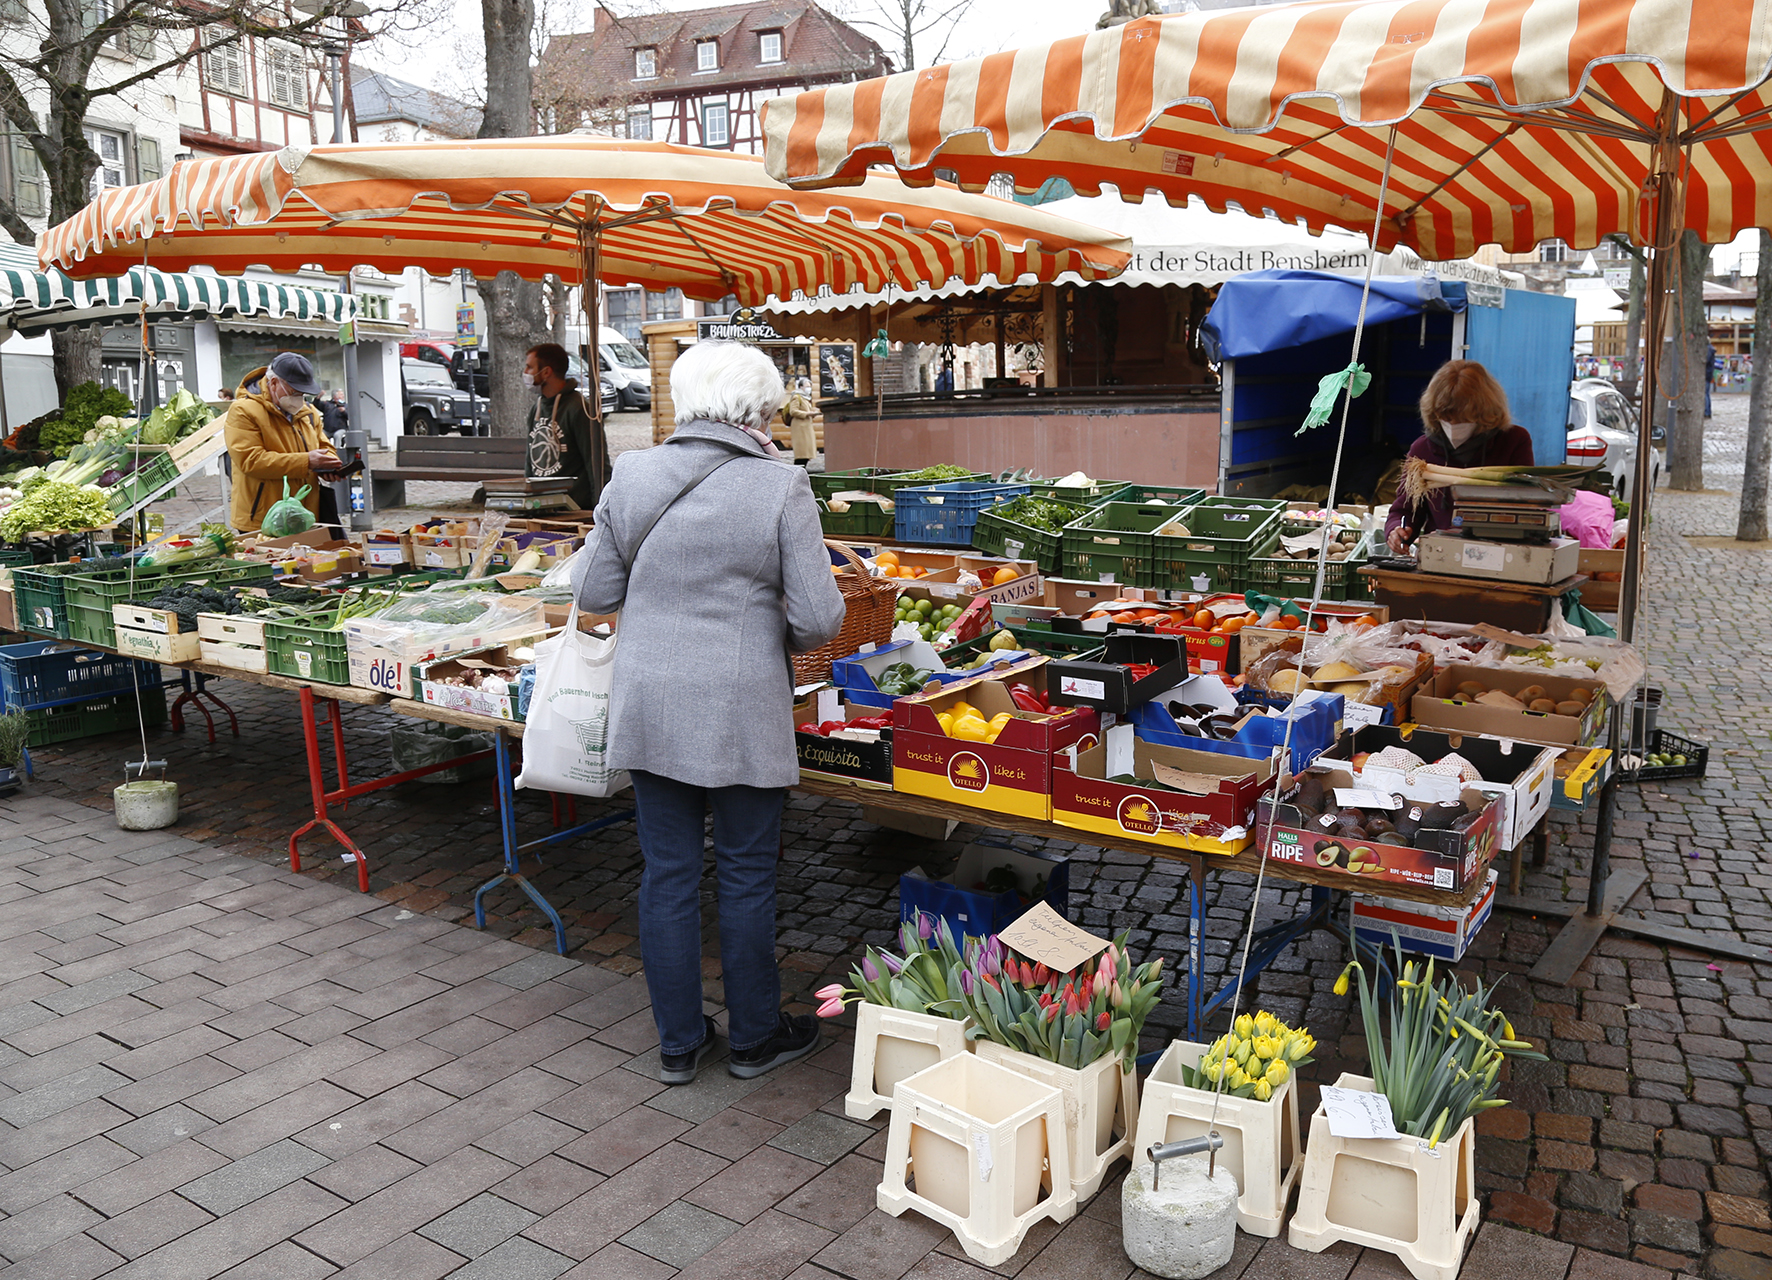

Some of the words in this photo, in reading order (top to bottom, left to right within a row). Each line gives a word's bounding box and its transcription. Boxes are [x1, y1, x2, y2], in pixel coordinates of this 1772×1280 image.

[1150, 251, 1188, 271] der
[1195, 251, 1253, 271] Stadt
[1261, 250, 1367, 271] Bensheim
[804, 744, 861, 768] Exquisita
[906, 749, 934, 763] trust
[934, 752, 944, 765] it
[994, 765, 1015, 779] like
[1016, 767, 1026, 780] it
[955, 778, 982, 789] OTELLO
[1075, 793, 1102, 807] trust
[1102, 796, 1112, 808] it
[1125, 821, 1154, 832] OTELLO
[1277, 832, 1298, 841] HALLS
[1271, 841, 1304, 863] RIPE
[1412, 928, 1457, 944] GRAPES
